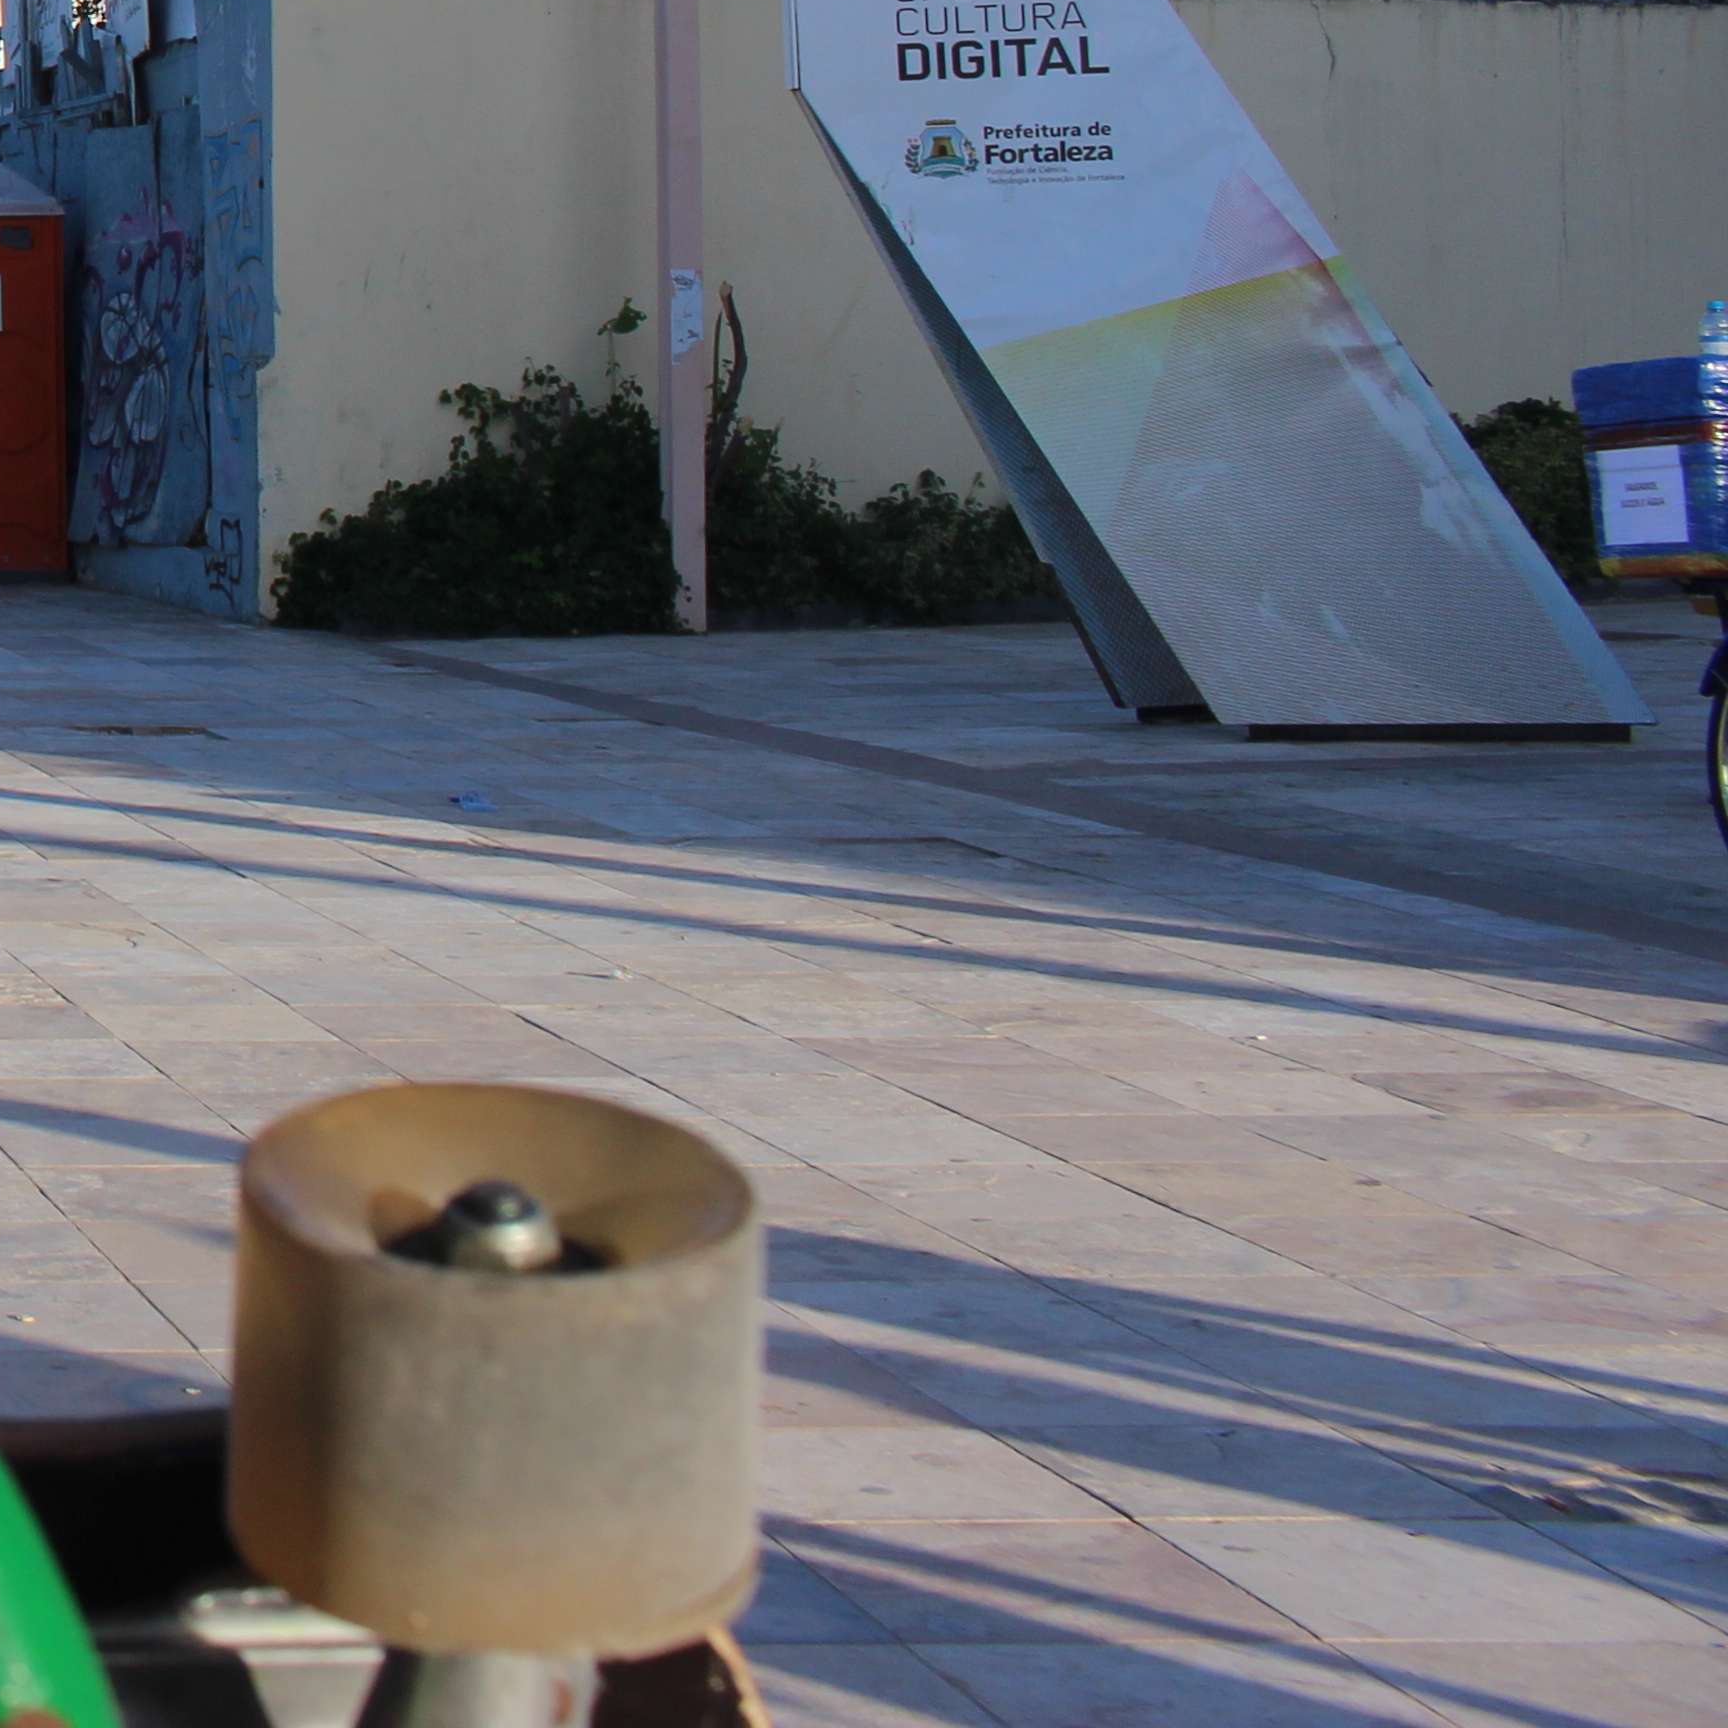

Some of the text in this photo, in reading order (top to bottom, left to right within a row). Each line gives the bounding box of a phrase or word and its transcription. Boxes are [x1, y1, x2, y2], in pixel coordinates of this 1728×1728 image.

[896, 1, 1087, 36] CULTURA
[897, 36, 1110, 81] DIGITAL
[984, 122, 1112, 139] Prefeitura de
[985, 141, 1113, 165] Fortaleza
